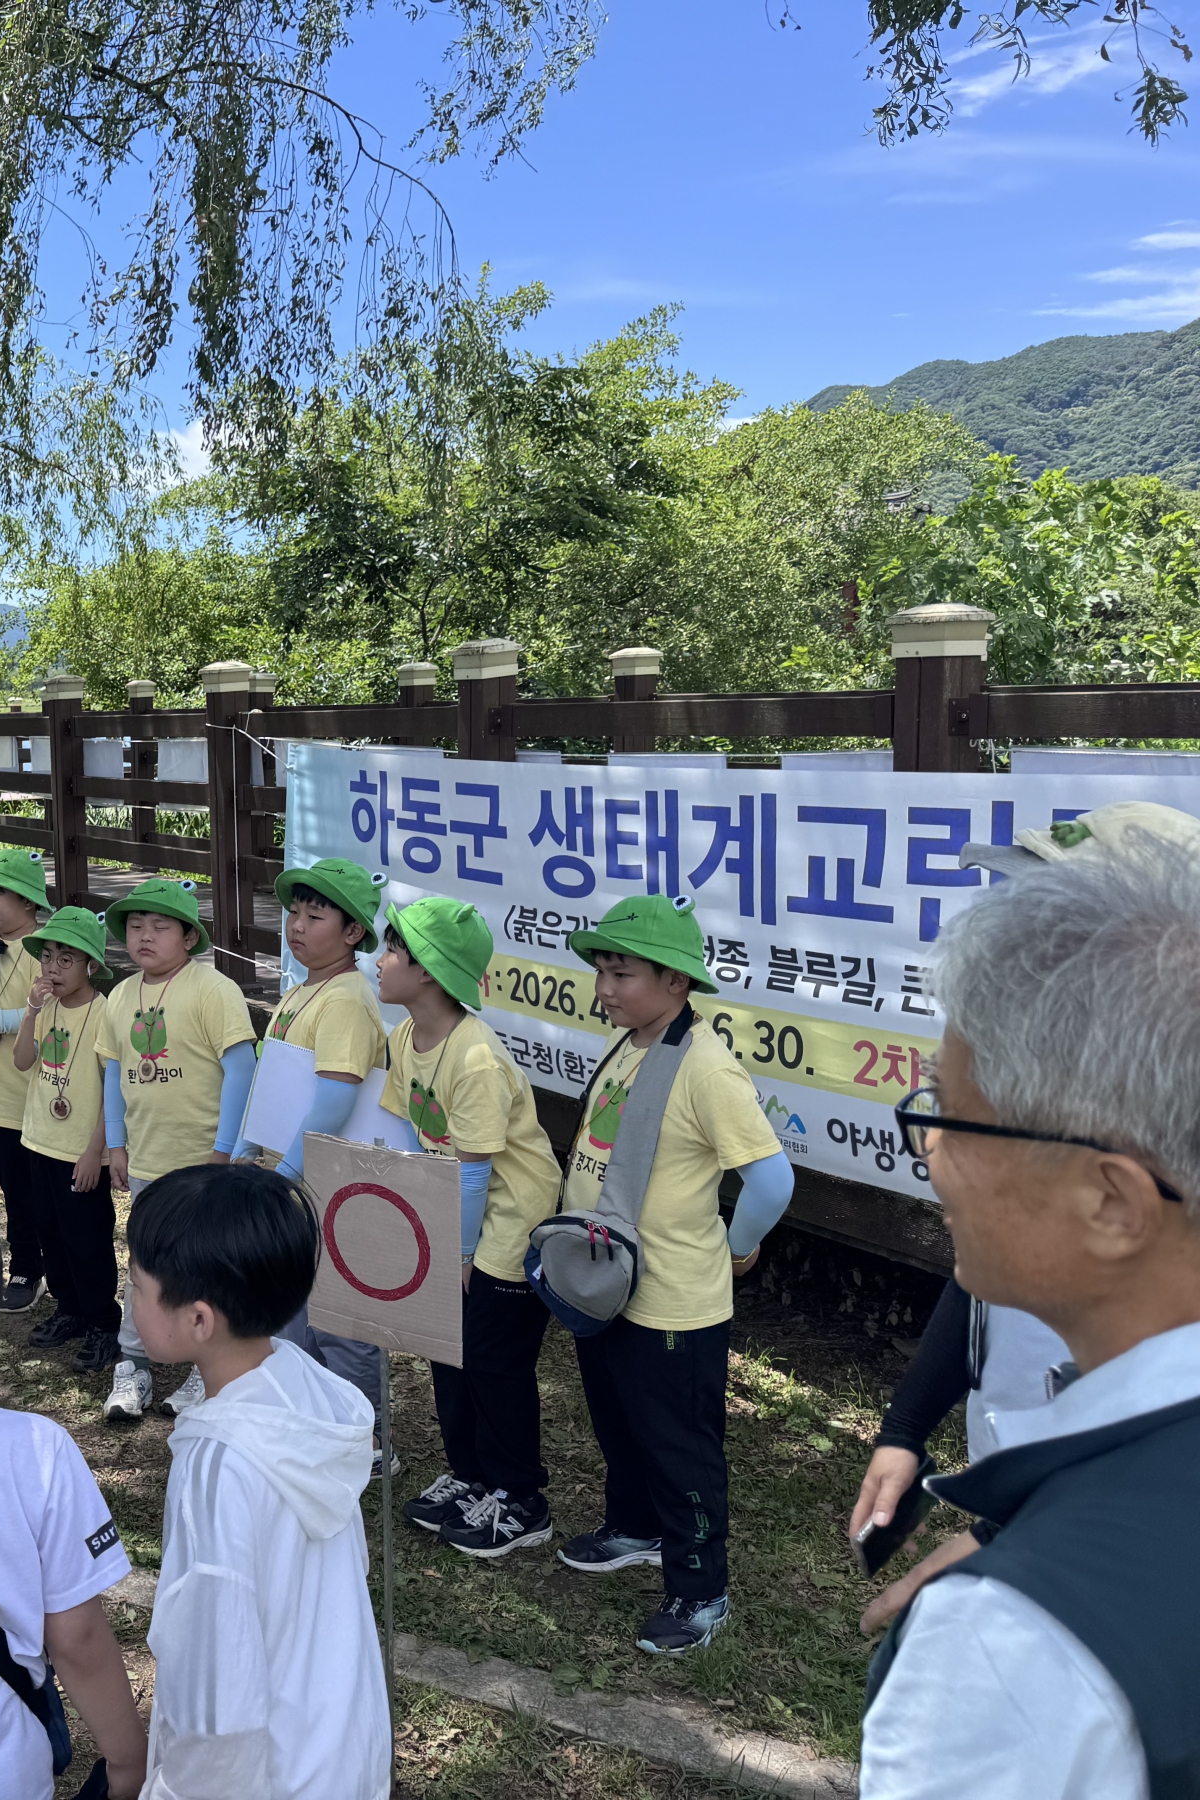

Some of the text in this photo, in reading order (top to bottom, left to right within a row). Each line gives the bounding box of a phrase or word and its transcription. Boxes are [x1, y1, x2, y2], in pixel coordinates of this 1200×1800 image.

[350, 769, 1092, 942] 하동군 생태계교란
[503, 904, 599, 951] (붉은귀
[766, 945, 885, 1012] 블루길,
[127, 1067, 183, 1084] 환킴이
[10, 1276, 27, 1285] NIKE
